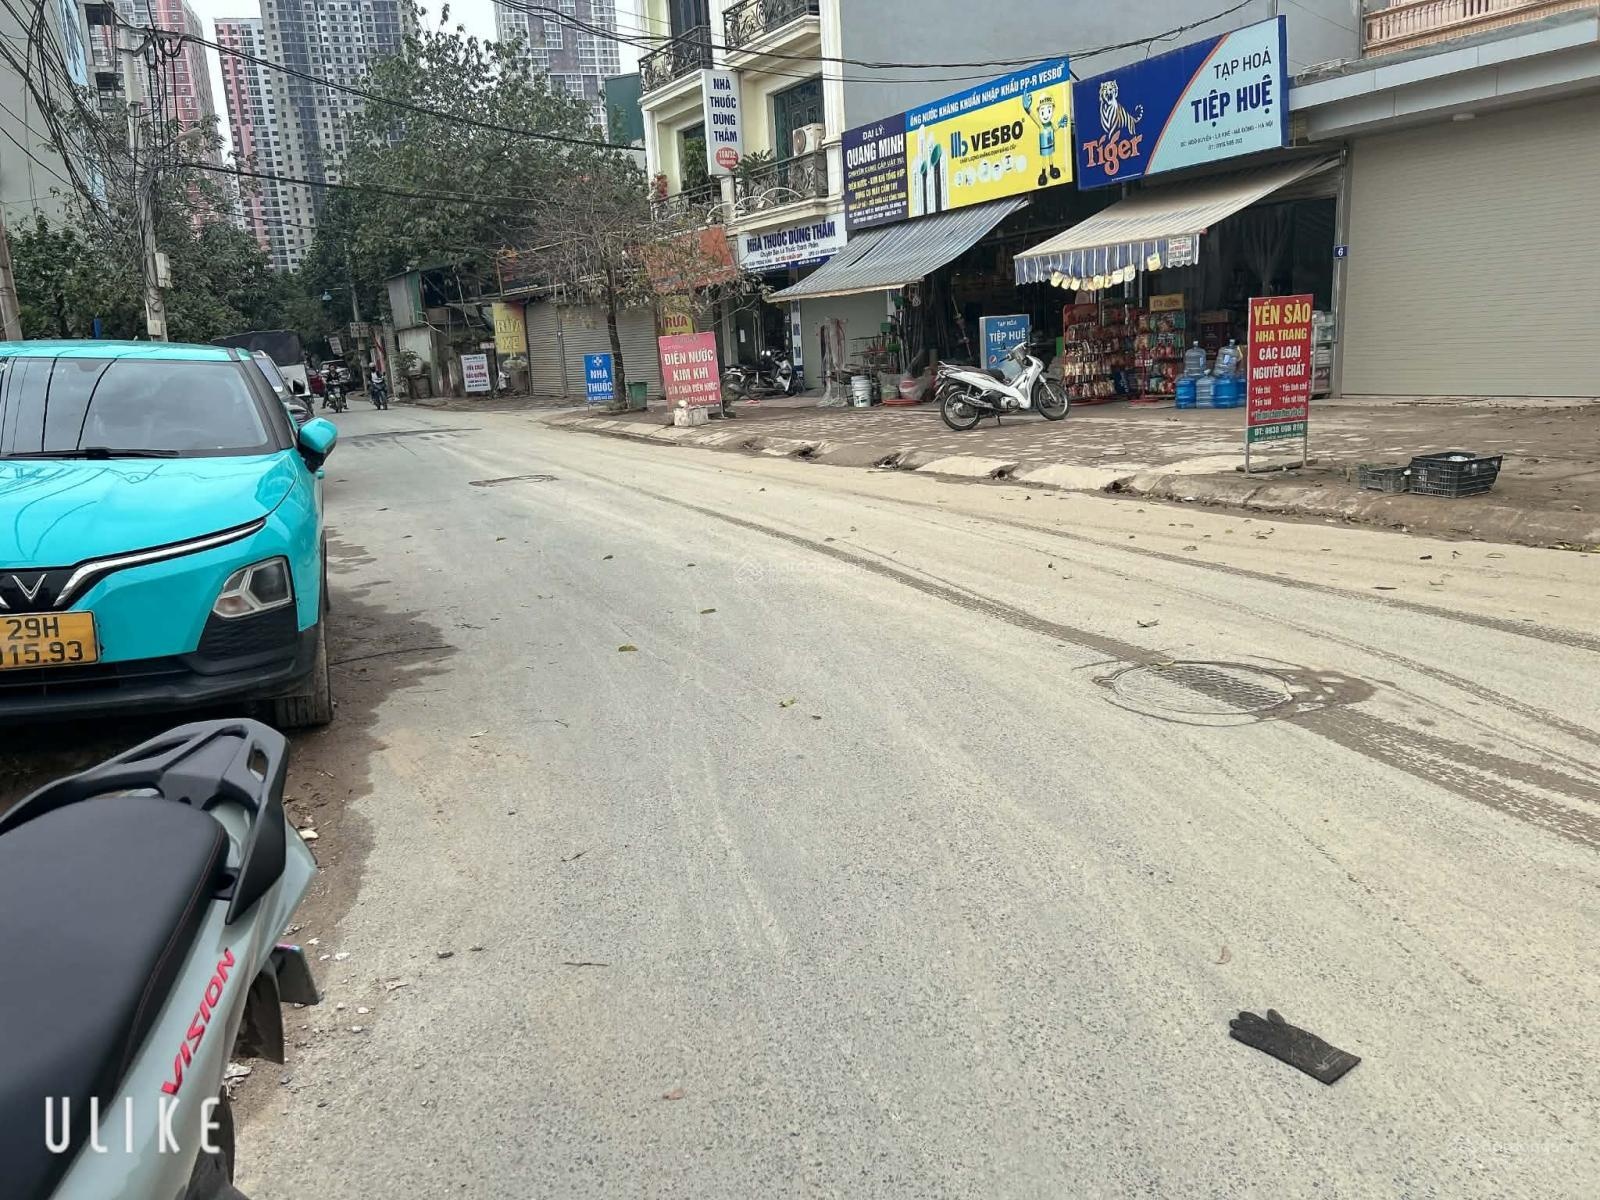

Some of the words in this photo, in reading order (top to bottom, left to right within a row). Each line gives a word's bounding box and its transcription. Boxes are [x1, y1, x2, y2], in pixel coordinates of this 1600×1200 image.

[1213, 58, 1239, 81] TẠP
[1242, 46, 1272, 72] HOÁ
[713, 76, 731, 90] NHÀ
[938, 102, 959, 117] KHÁNG
[981, 86, 1000, 104] NHẬP
[1020, 76, 1037, 91] PP-R
[1038, 66, 1063, 85] VESBO
[709, 93, 736, 108] THUỐC
[1191, 88, 1231, 127] TIỆP
[1236, 74, 1273, 114] HUỆ
[862, 129, 874, 141] ĐẠI
[970, 120, 1024, 152] VESBO
[846, 141, 877, 169] QUANG
[878, 133, 904, 159] MINH
[1083, 131, 1143, 176] Tiger
[747, 233, 763, 253] NHÀ
[763, 229, 788, 250] THUỐC
[1338, 247, 1343, 256] 6
[1254, 299, 1281, 326] YẾN
[1283, 299, 1311, 325] SÀO
[989, 329, 1007, 344] TIỆP
[1255, 330, 1275, 343] NHA
[1278, 327, 1307, 341] TRANG
[664, 350, 687, 367] ĐIỆN
[688, 347, 714, 364] NƯỚC
[1259, 345, 1278, 361] CÁC
[1280, 345, 1302, 361] LOẠI
[590, 367, 609, 379] NHÀ
[672, 367, 691, 382] KIM
[693, 364, 709, 380] KHÍ
[1252, 363, 1285, 380] NGUYÊN
[1285, 359, 1306, 377] CHẤT
[587, 379, 613, 393] THUỐC
[6, 616, 60, 640] 29H
[160, 946, 236, 1096] VISION
